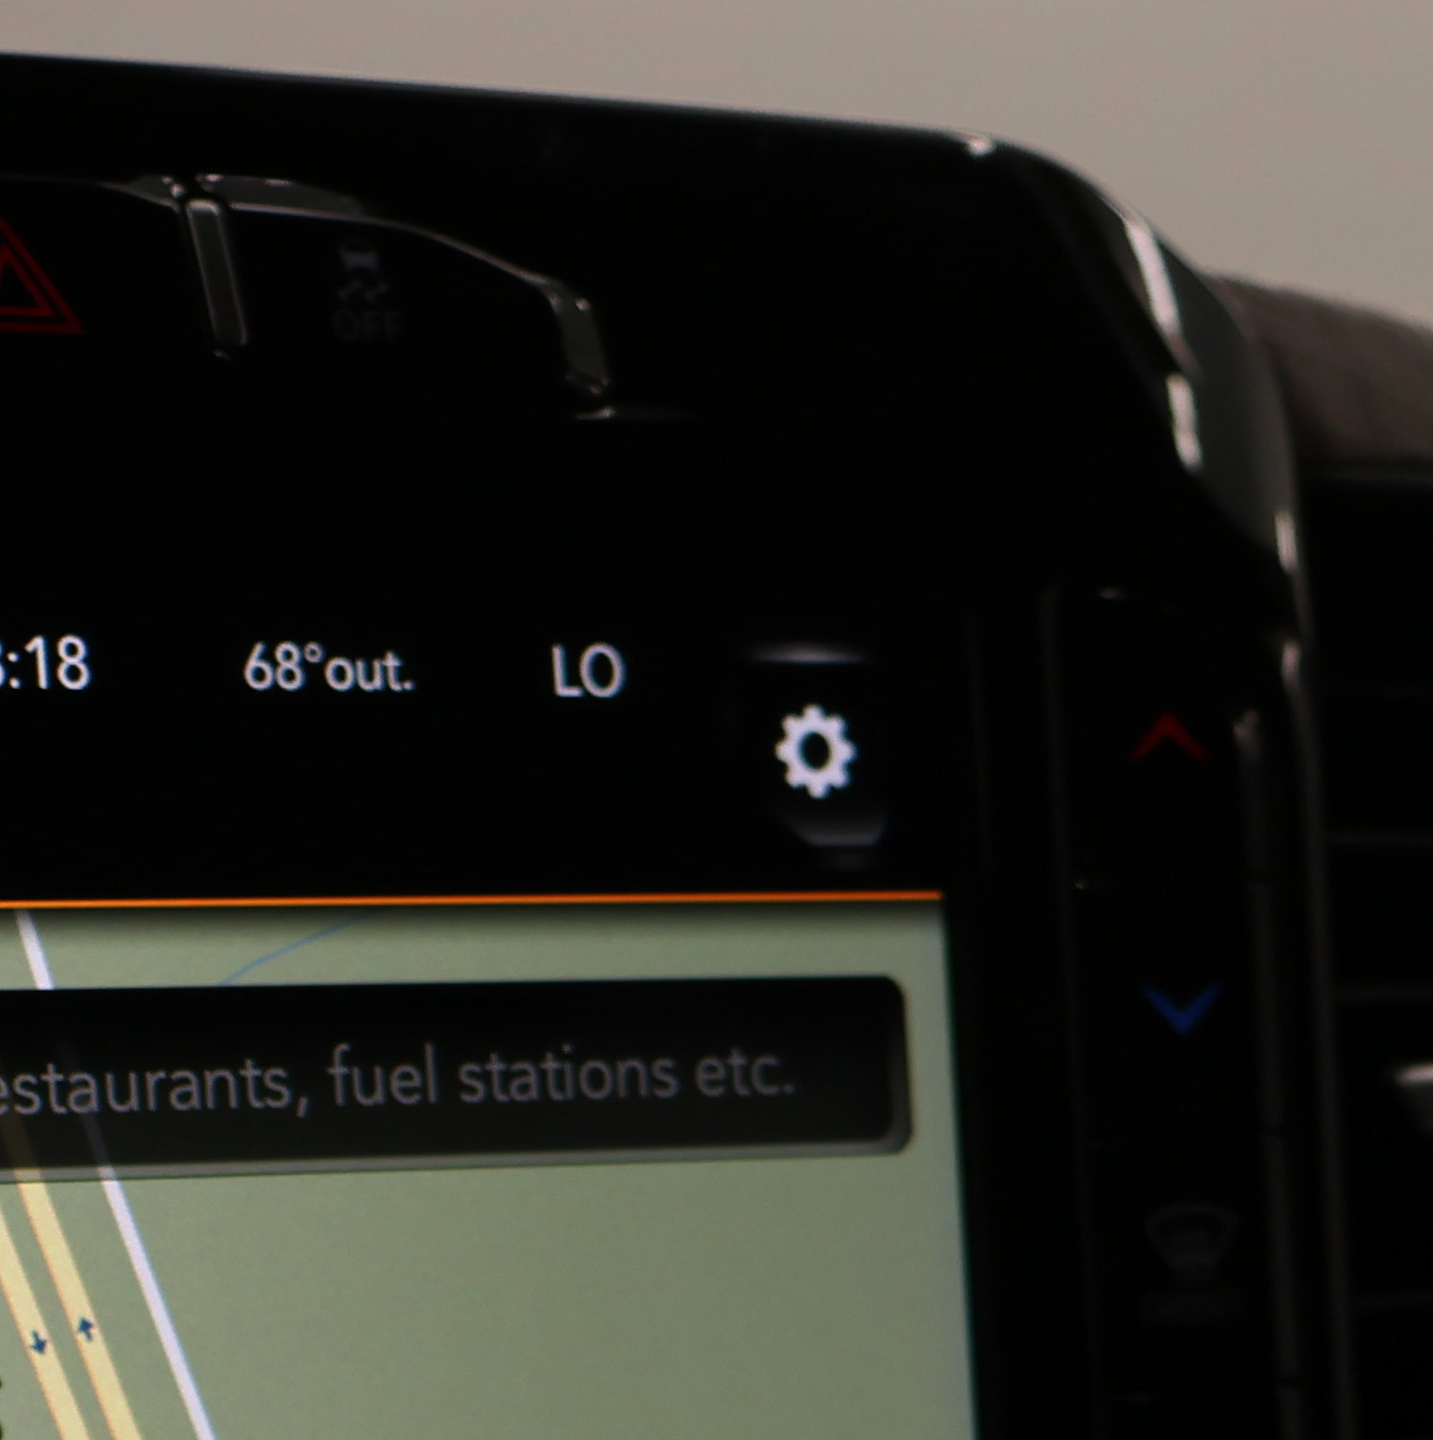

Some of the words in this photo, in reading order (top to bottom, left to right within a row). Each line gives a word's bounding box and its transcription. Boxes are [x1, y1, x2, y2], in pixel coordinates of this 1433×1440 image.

[552, 643, 625, 698] LO
[327, 1043, 439, 1107] fuel
[458, 1044, 681, 1104] stations
[694, 1048, 796, 1098] etc.
